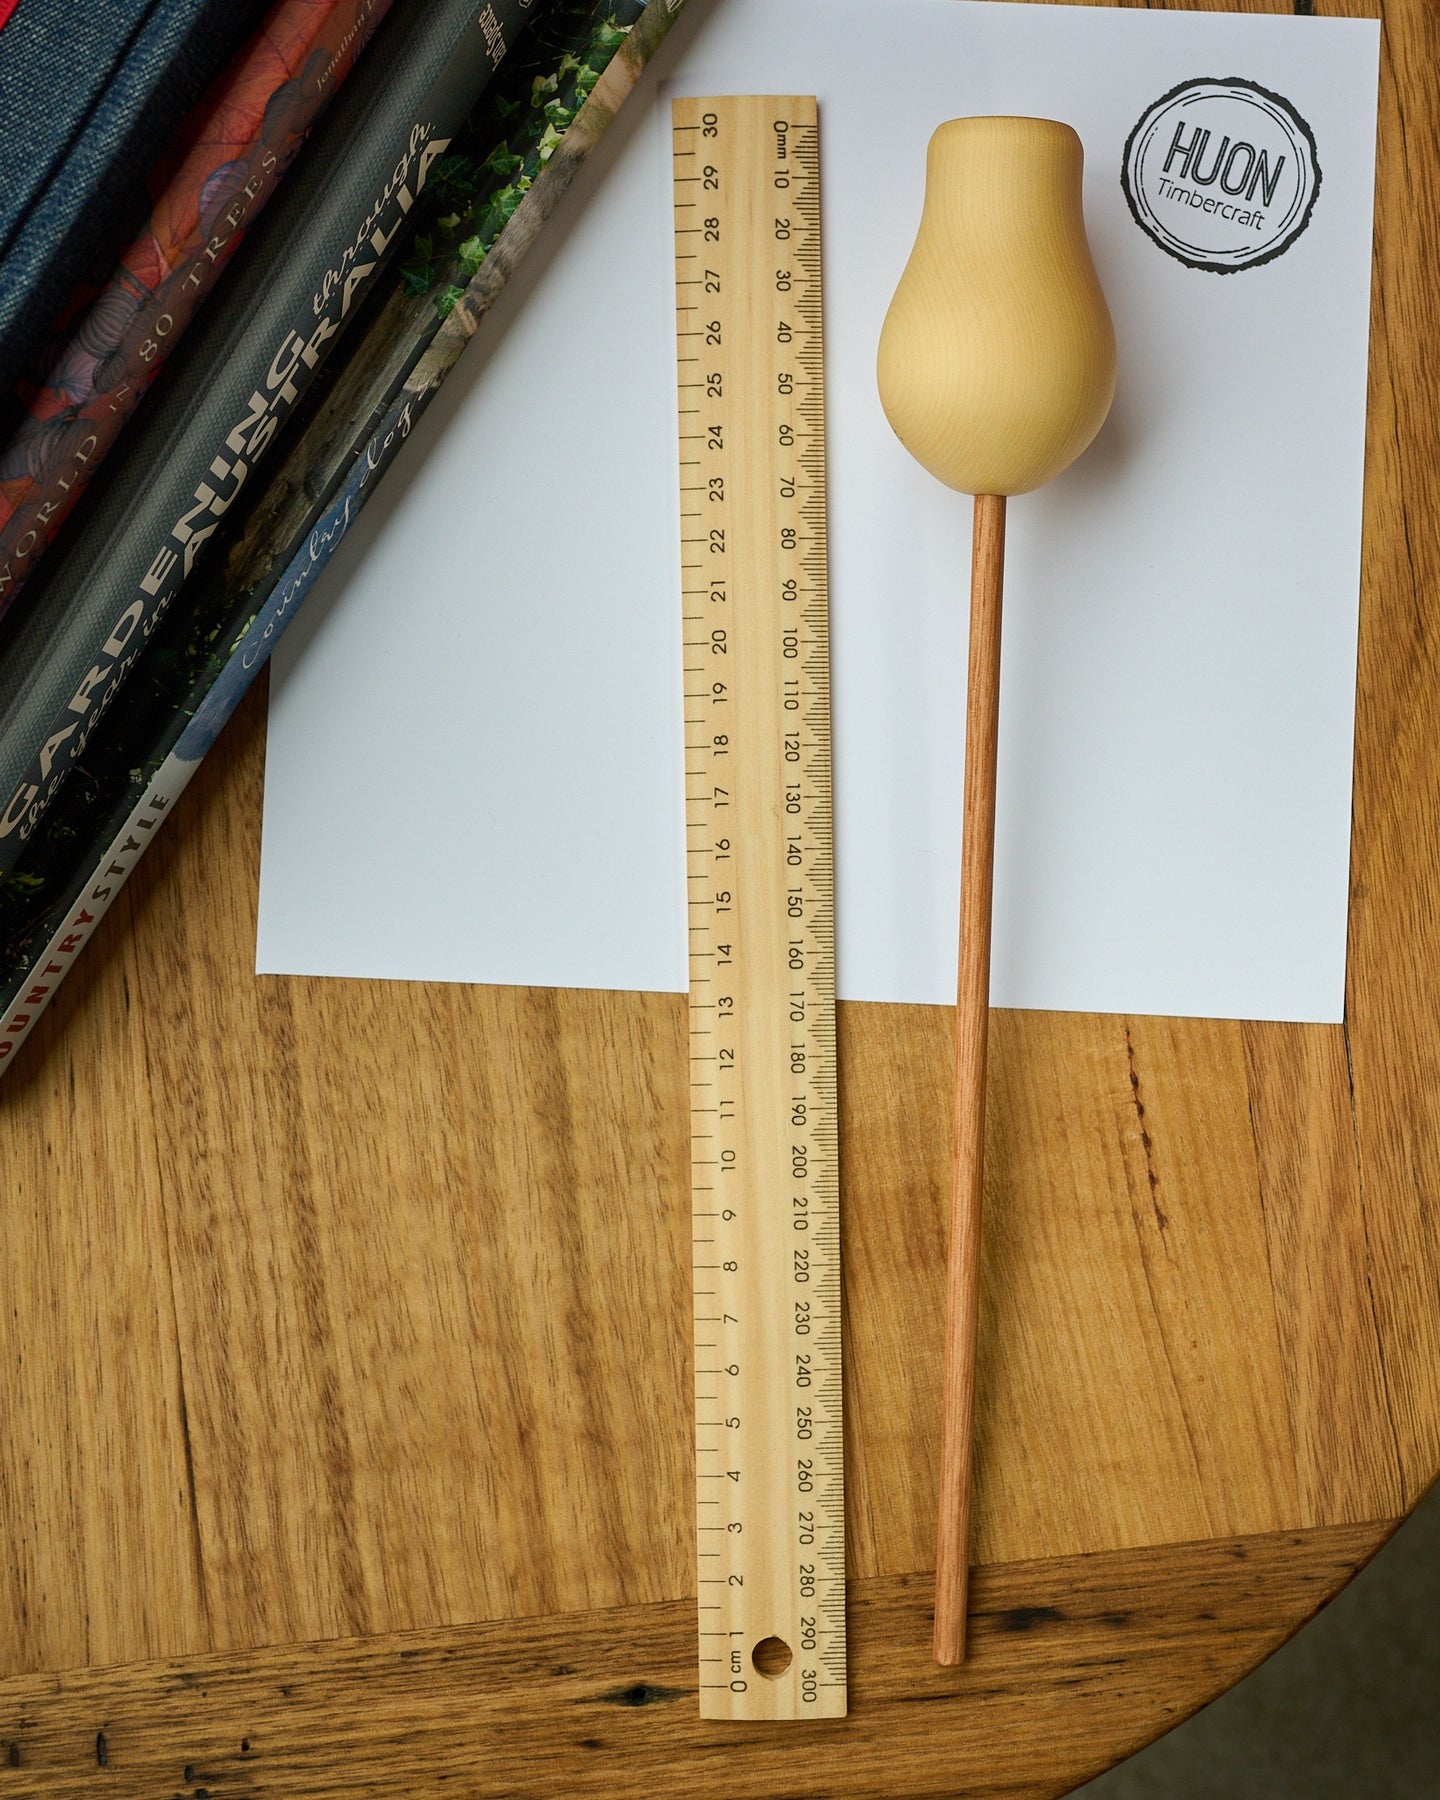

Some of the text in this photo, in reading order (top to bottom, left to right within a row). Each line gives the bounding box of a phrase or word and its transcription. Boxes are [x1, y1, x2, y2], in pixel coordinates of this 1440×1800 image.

[478, 3, 504, 56] Spence
[317, 13, 365, 92] Jonathan
[702, 112, 719, 139] 30
[772, 120, 789, 160] 0mm
[1162, 121, 1286, 208] HUON
[702, 165, 719, 191] 29
[773, 168, 790, 189] 10
[1158, 177, 1265, 231] Timbercraft
[703, 216, 720, 243] 28
[774, 217, 791, 241] 20
[108, 382, 132, 412] IN
[138, 312, 174, 363] 80
[182, 149, 279, 295] TREES
[704, 269, 721, 294] 27
[775, 269, 792, 292] 30
[705, 320, 722, 346] 26
[776, 320, 793, 344] 40
[184, 137, 452, 579] AUSTRALIA
[706, 372, 723, 399] 25
[777, 372, 794, 395] 50
[707, 425, 724, 451] 24
[778, 424, 795, 447] 60
[0, 121, 436, 841] GARDENING through
[708, 477, 725, 502] 23
[779, 476, 796, 499] 70
[709, 528, 726, 554] 22
[780, 527, 797, 550] 80
[242, 494, 354, 670] Country
[710, 580, 727, 603] 21
[781, 578, 798, 602] 90
[711, 629, 728, 655] 20
[782, 627, 799, 659] 100
[711, 681, 729, 705] 19
[783, 679, 800, 711] 110
[19, 590, 176, 842] the year in
[713, 734, 729, 757] 18
[784, 731, 801, 763] 120
[713, 786, 730, 809] 17
[785, 783, 802, 815] 130
[714, 838, 731, 862] 16
[786, 835, 803, 866] 140
[715, 890, 732, 915] 15
[787, 886, 804, 918] 150
[716, 943, 733, 967] 14
[787, 938, 805, 970] 160
[717, 996, 734, 1019] 13
[789, 991, 806, 1023] 170
[718, 1048, 735, 1071] 12
[790, 1042, 806, 1074] 180
[719, 1100, 735, 1120] 11
[790, 1095, 807, 1127] 190
[720, 1149, 736, 1173] 10
[791, 1144, 808, 1179] 200
[721, 1209, 737, 1222] 9
[792, 1196, 809, 1231] 210
[722, 1260, 739, 1273] 8
[793, 1249, 810, 1283] 220
[723, 1313, 739, 1325] 7
[794, 1301, 811, 1336] 230
[724, 1364, 740, 1377] 6
[795, 1354, 812, 1388] 240
[725, 1416, 741, 1430] 5
[796, 1406, 813, 1441] 250
[726, 1470, 741, 1483] 4
[797, 1458, 814, 1493] 260
[727, 1522, 743, 1534] 3
[798, 1511, 815, 1545] 270
[727, 1574, 744, 1587] 2
[799, 1563, 816, 1598] 280
[800, 1616, 817, 1651] 290
[729, 1650, 748, 1693] 0 cm
[801, 1669, 818, 1703] 300
